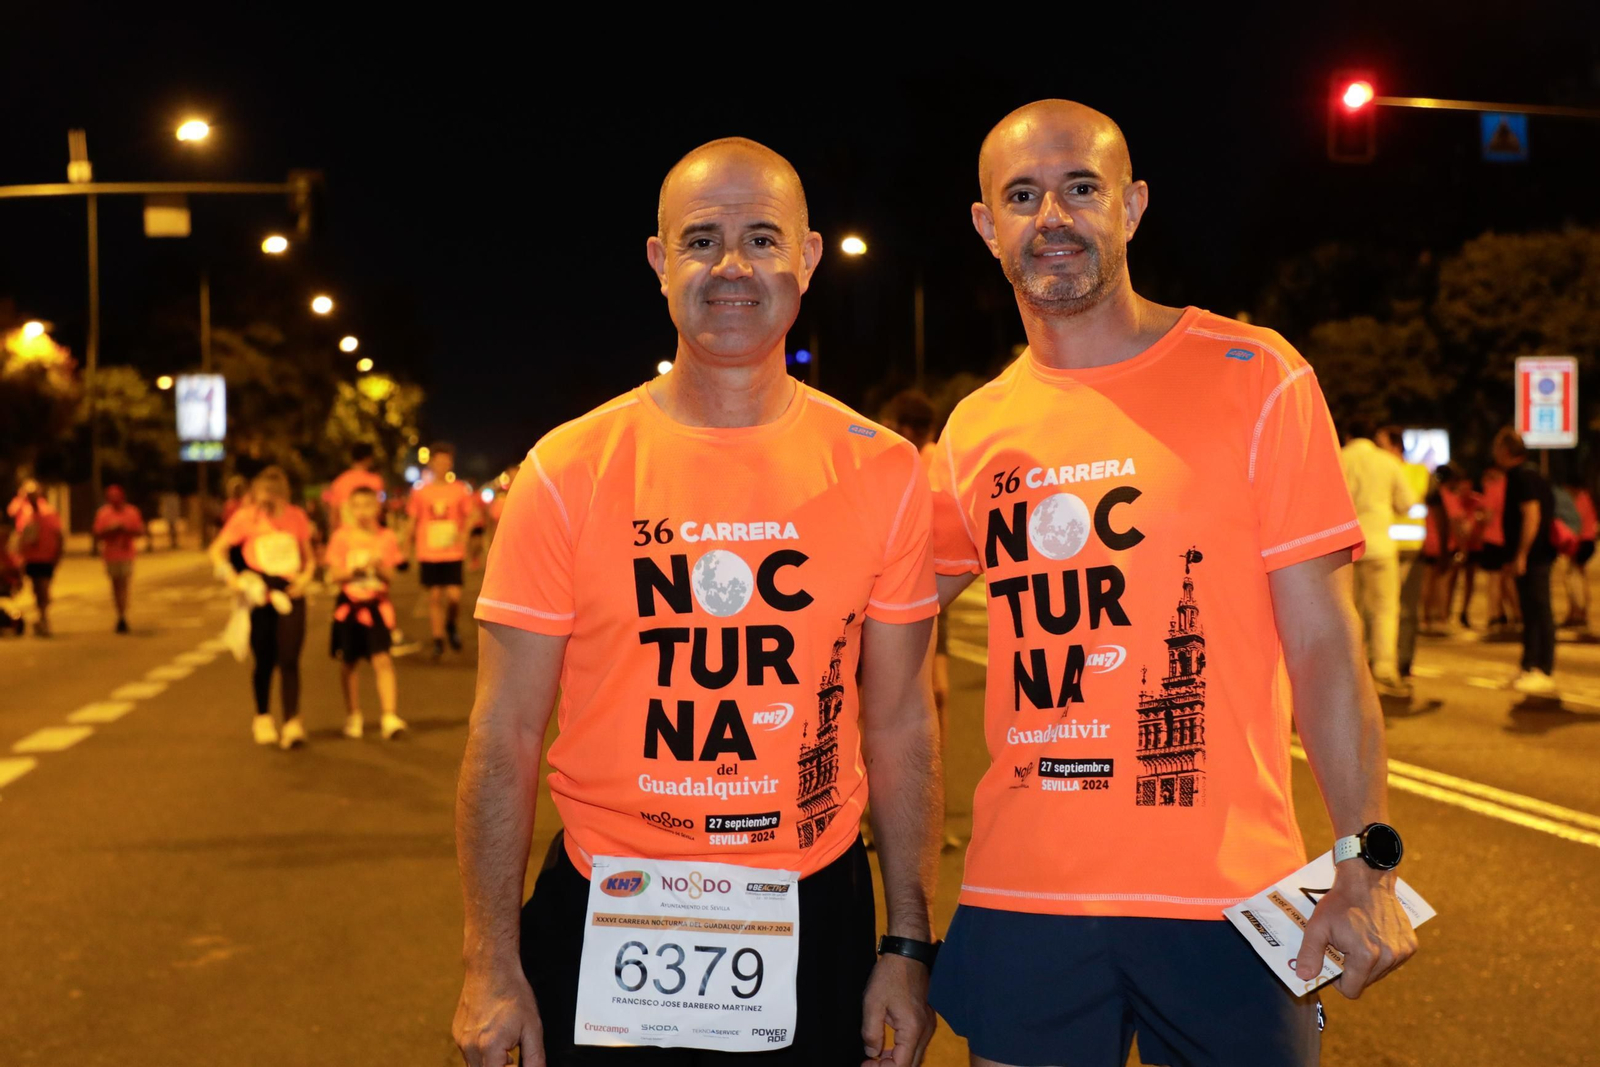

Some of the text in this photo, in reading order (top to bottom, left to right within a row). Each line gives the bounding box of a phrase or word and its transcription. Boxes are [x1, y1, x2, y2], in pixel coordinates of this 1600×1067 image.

[990, 458, 1136, 499] 36 CARRERA
[632, 518, 799, 546] 36 CARRERA
[989, 565, 1132, 639] TUR
[639, 625, 800, 690] TUR
[1013, 644, 1085, 712] NA
[644, 698, 757, 761] NA
[716, 763, 738, 776] del
[1041, 761, 1110, 776] 27 septiembre
[638, 773, 779, 800] Guadalquivir
[1041, 779, 1079, 791] SEVILLA
[1082, 780, 1109, 790] 2024
[709, 816, 778, 831] 27 septiembre
[709, 830, 775, 845] SEVILLA 2024
[606, 877, 642, 892] KH-7
[1272, 894, 1288, 907] 2024
[651, 919, 688, 927] NOCTURNA
[704, 922, 756, 931] GUADALQUIVIR
[614, 940, 764, 999] 6379
[612, 996, 762, 1012] FRANCISCO JOSE BARBERO MARTINEZ
[584, 1022, 629, 1034] Cruzcampo
[752, 1028, 787, 1037] POWER
[767, 1035, 786, 1043] ADE
